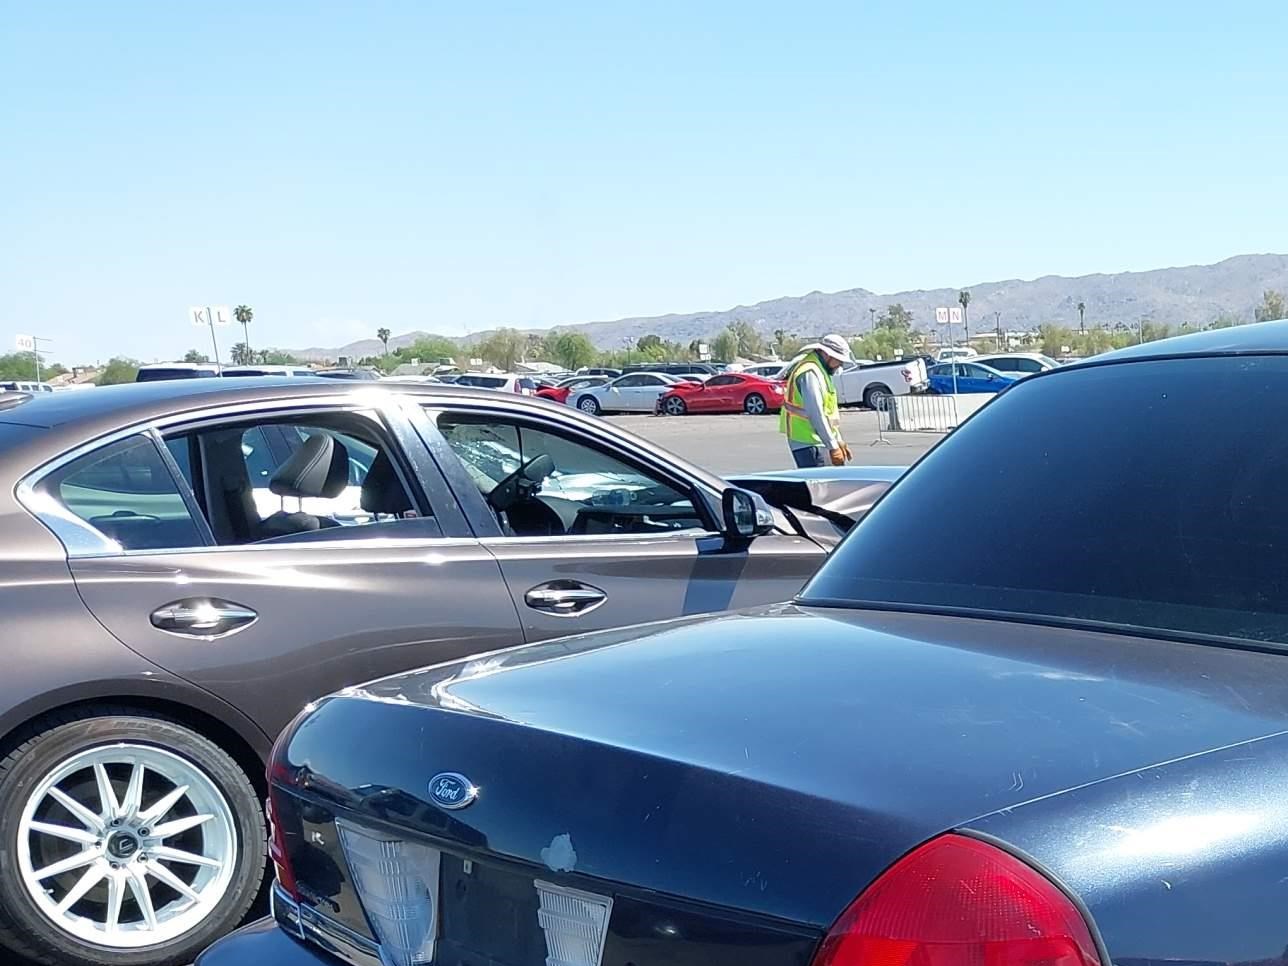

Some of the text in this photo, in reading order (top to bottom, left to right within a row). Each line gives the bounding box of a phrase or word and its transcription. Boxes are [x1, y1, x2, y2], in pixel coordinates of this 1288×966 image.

[193, 310, 205, 324] K
[217, 310, 227, 323] L
[938, 311, 947, 321] M
[951, 311, 960, 321] N
[435, 778, 460, 801] Ford
